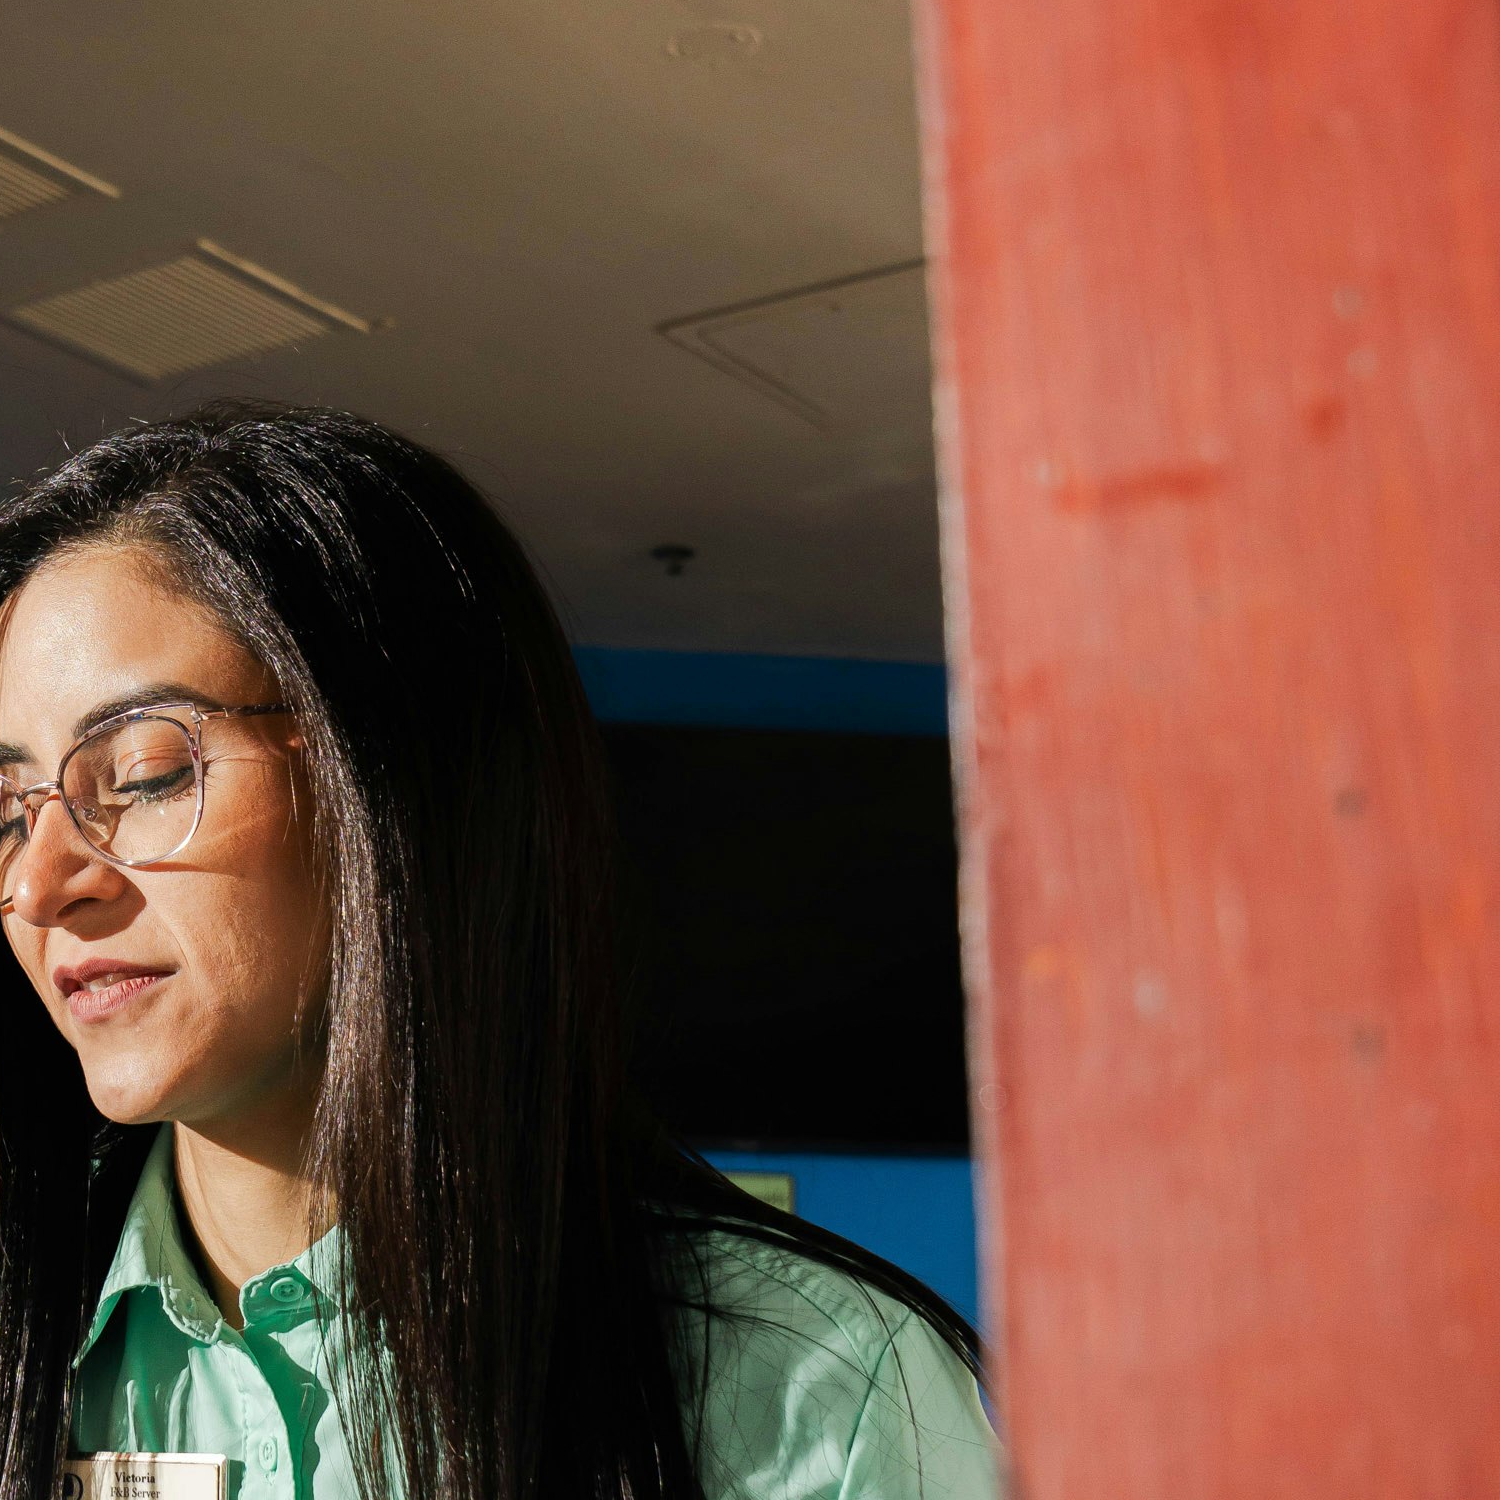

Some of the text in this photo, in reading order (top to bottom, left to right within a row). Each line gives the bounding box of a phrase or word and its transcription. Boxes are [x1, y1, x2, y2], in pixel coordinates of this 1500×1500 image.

[114, 1471, 156, 1484] Victoria
[110, 1486, 161, 1499] F&B Server
